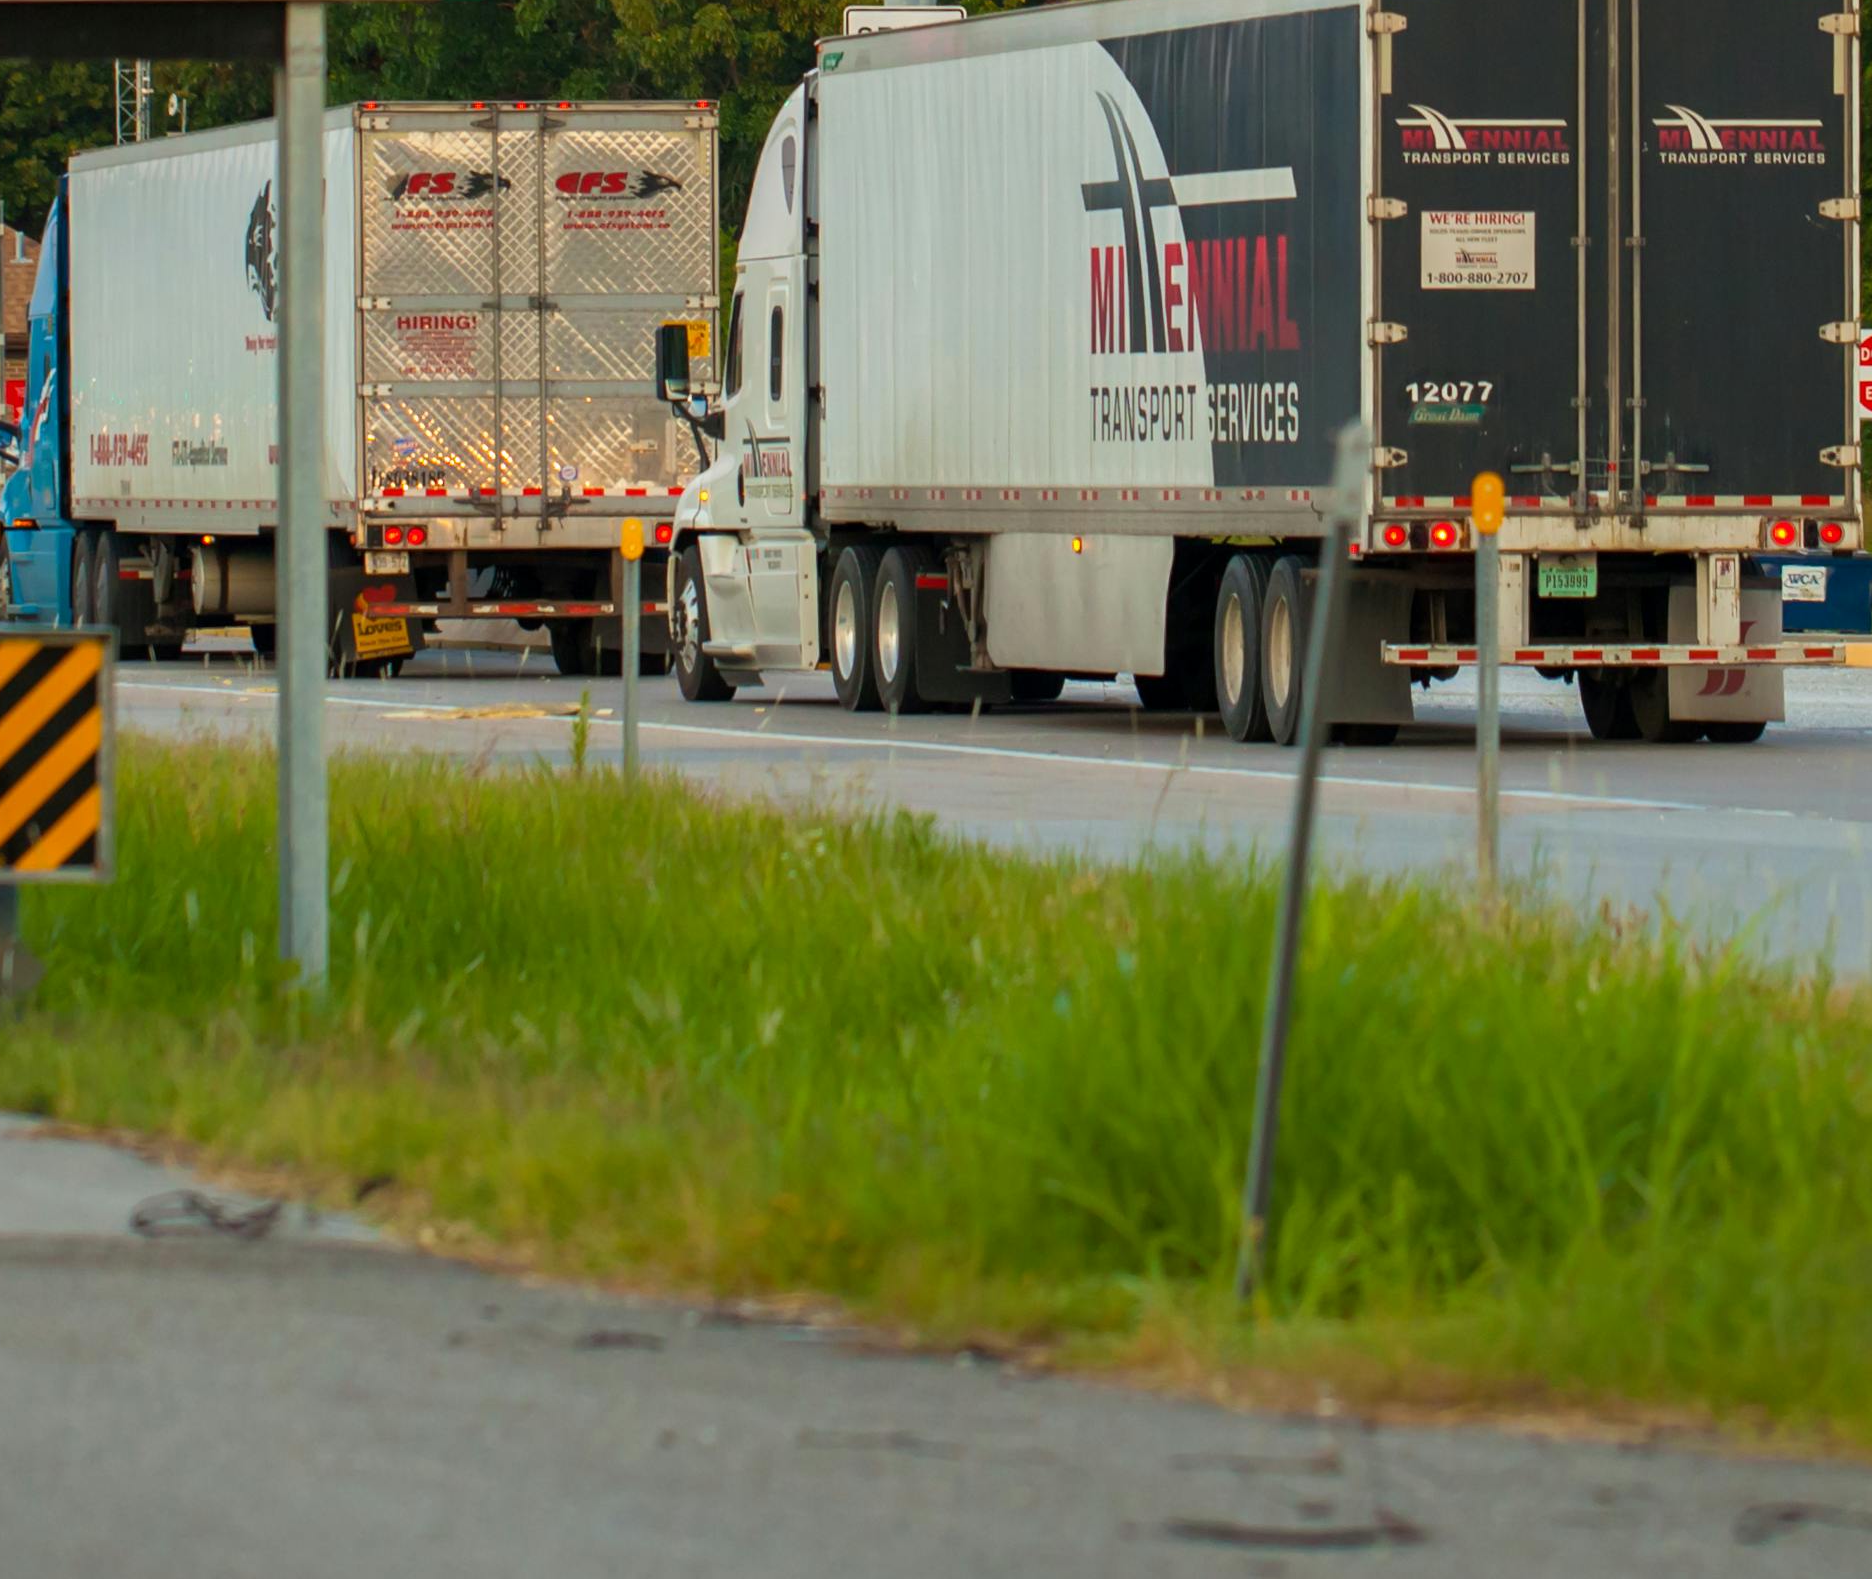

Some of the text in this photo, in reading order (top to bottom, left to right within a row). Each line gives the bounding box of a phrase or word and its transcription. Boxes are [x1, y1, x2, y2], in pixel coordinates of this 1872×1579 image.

[1403, 152, 1570, 164] TRANSPORT SERVICES
[1659, 152, 1826, 164] TRANSPORT SERVICES
[1429, 213, 1525, 224] WE'RE HIRING!
[1427, 273, 1528, 284] 1-800-880-2707
[1091, 235, 1301, 354] MILLENNIAL
[397, 316, 477, 330] HIRING!
[1406, 381, 1493, 402] 12077
[1091, 382, 1299, 441] TRANSPORT SERVICES
